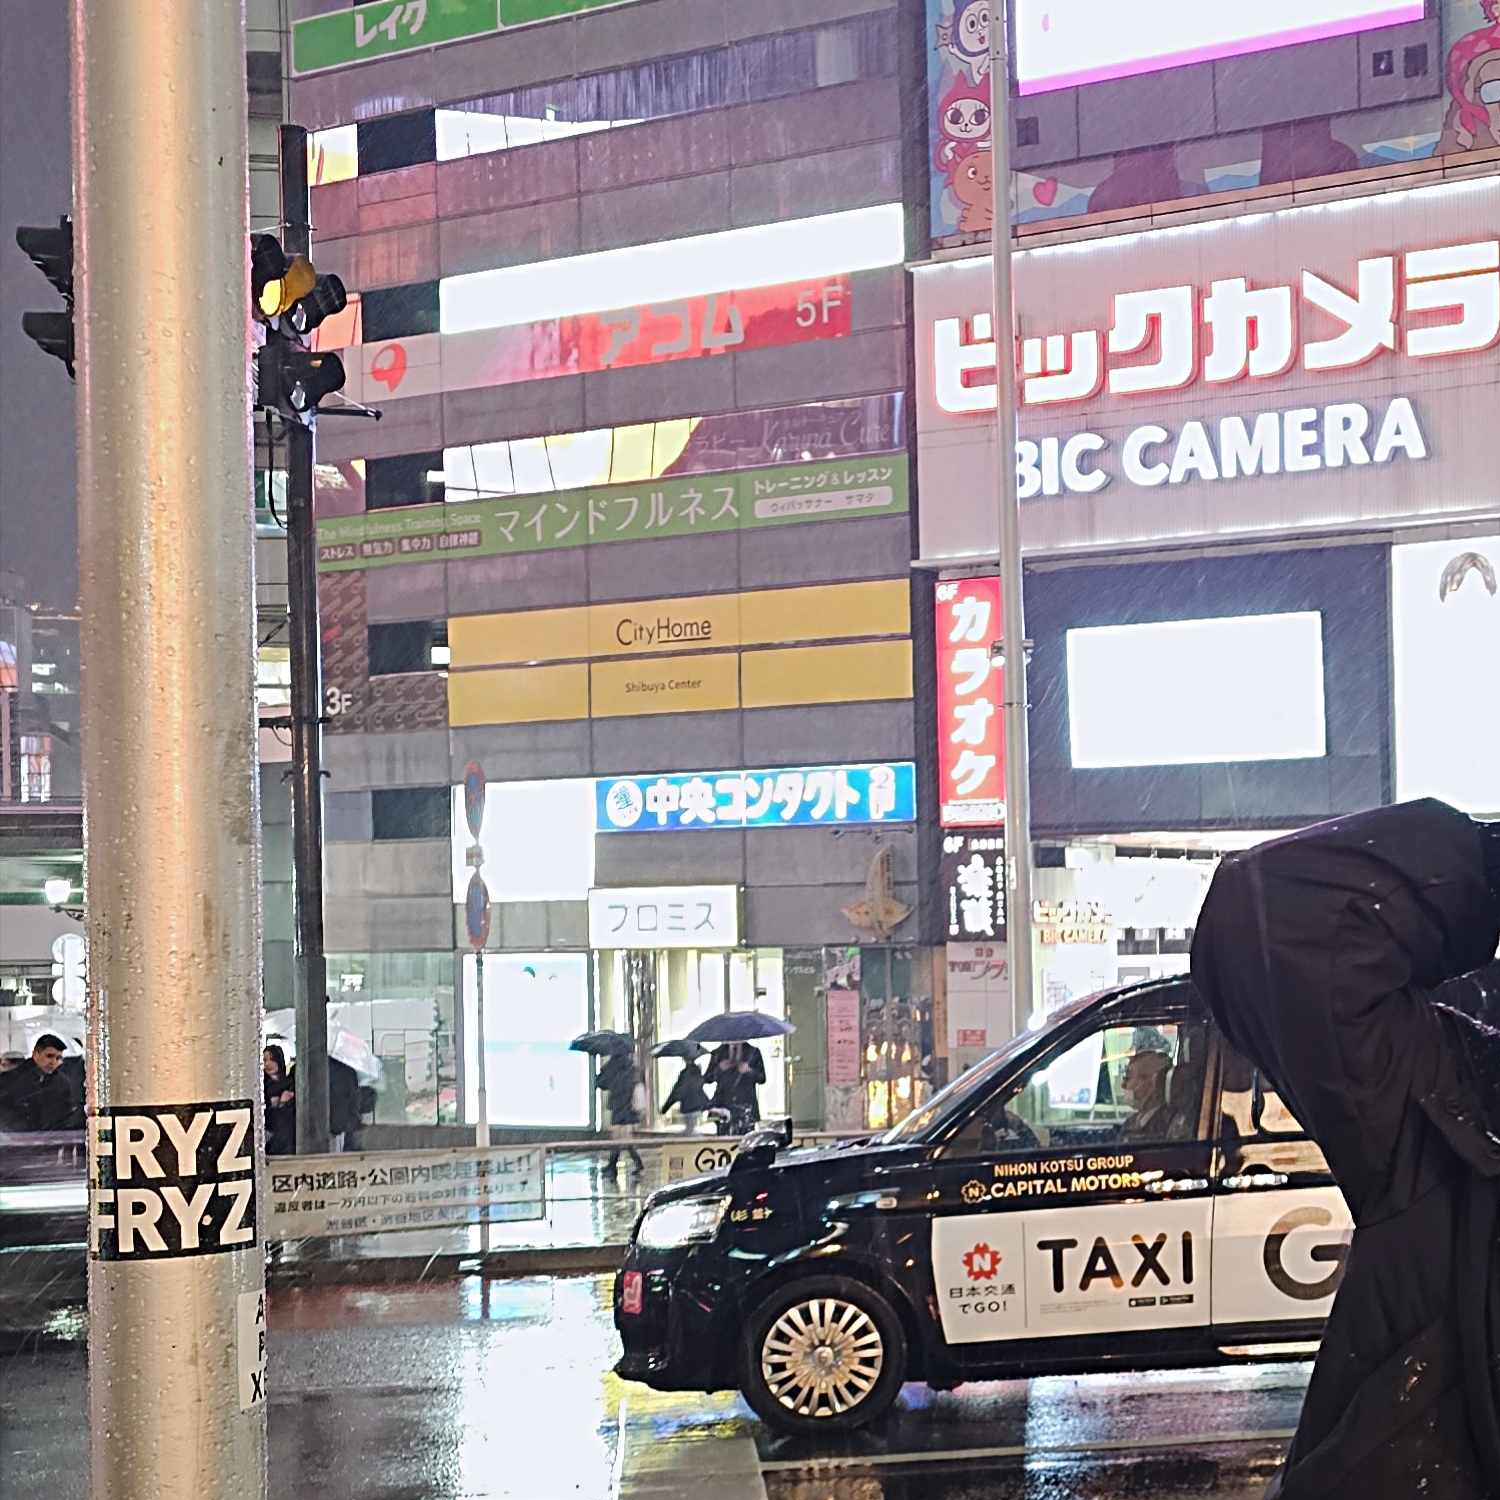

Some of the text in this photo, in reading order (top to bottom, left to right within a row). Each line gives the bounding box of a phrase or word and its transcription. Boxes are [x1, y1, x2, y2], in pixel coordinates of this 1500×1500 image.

[355, 0, 428, 48] レイク
[600, 285, 843, 365] アコム 5F
[1122, 397, 1427, 487] CAMERA
[495, 486, 740, 543] マインドフルネス
[615, 617, 712, 646] CityHome
[326, 686, 352, 715] 3F
[625, 678, 702, 694] Shibuya Center
[950, 595, 996, 796] カラオケ
[645, 769, 861, 826] 中央コンタクト
[89, 1108, 252, 1180] FRYZ
[994, 1154, 1134, 1177] NIHON KOTSU GROUP
[990, 1171, 1141, 1198] CAPITAL MOTORS
[90, 1179, 254, 1253] FRYZ
[1036, 1230, 1194, 1293] TAXI
[949, 1283, 1016, 1299] 日本交通
